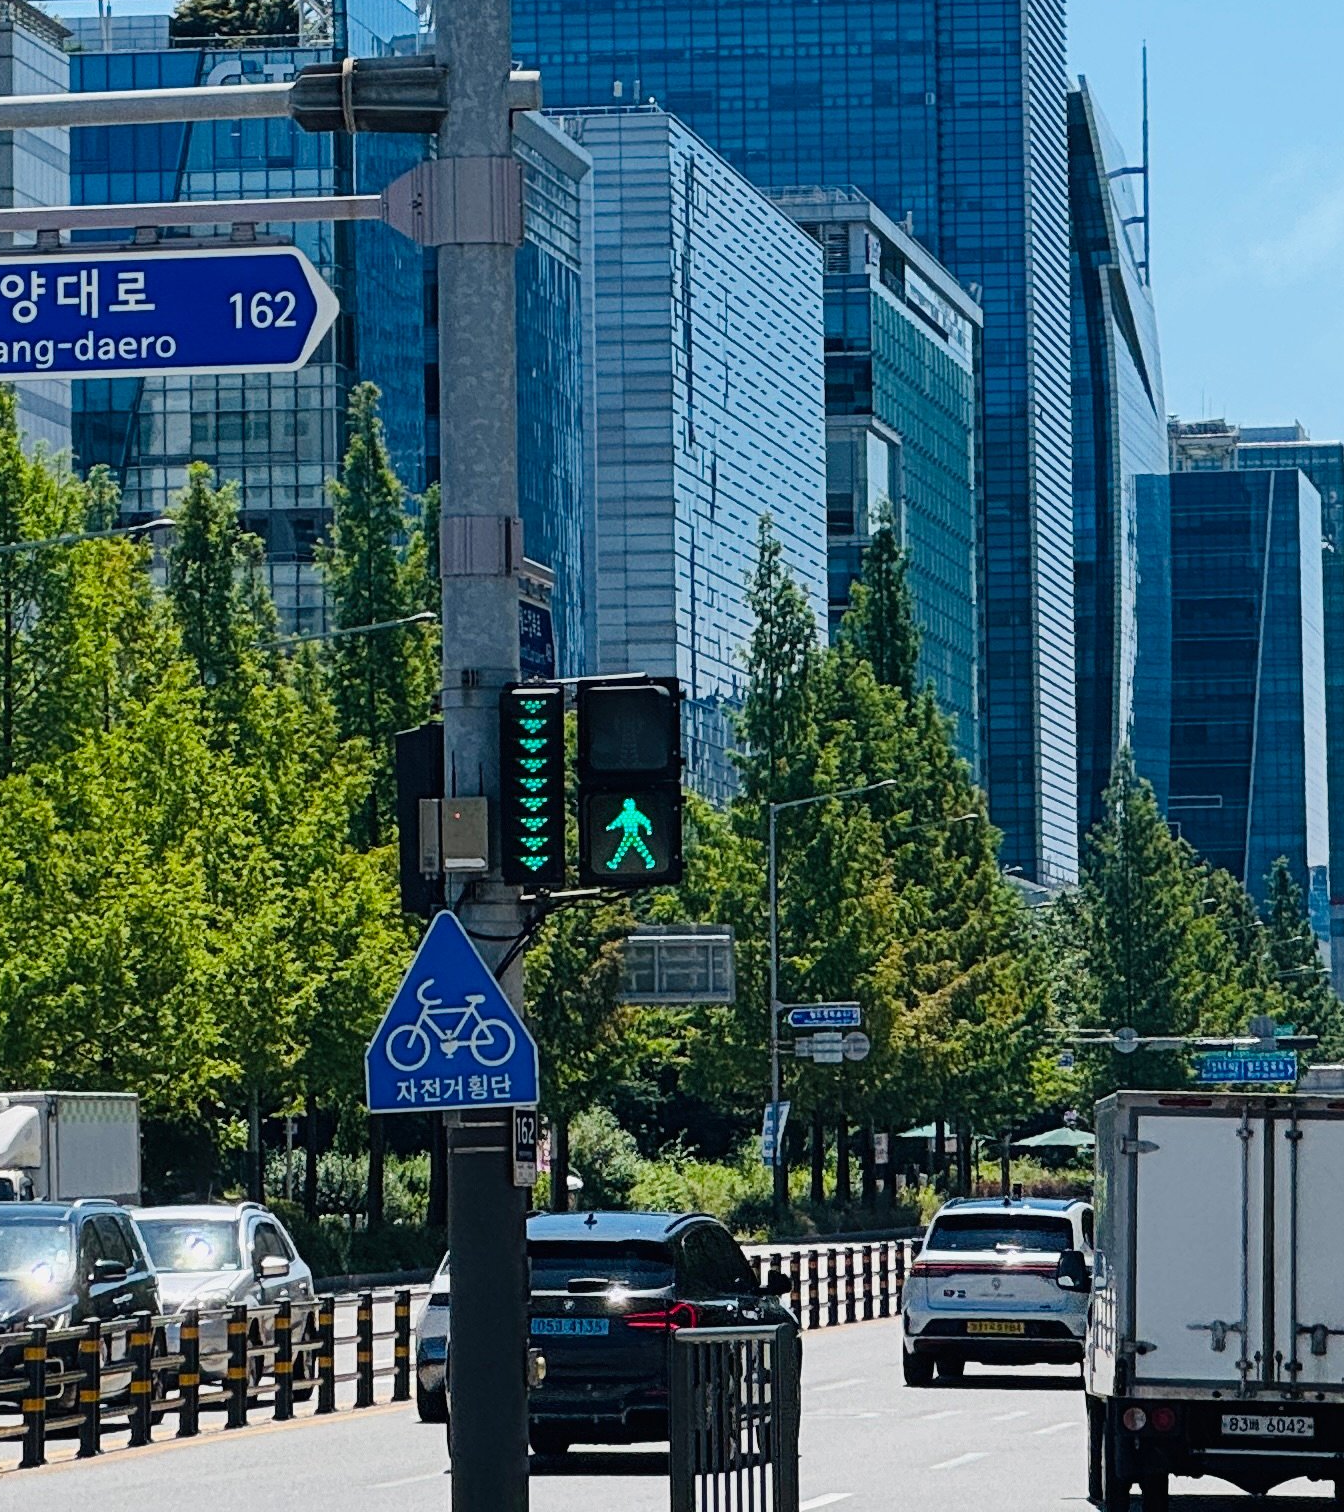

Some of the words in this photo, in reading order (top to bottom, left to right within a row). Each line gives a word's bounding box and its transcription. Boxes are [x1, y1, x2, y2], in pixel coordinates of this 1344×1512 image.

[228, 291, 298, 330] 162
[396, 1072, 512, 1104] 자전거횡단
[516, 1116, 535, 1145] 162
[1266, 1417, 1306, 1434] 6042
